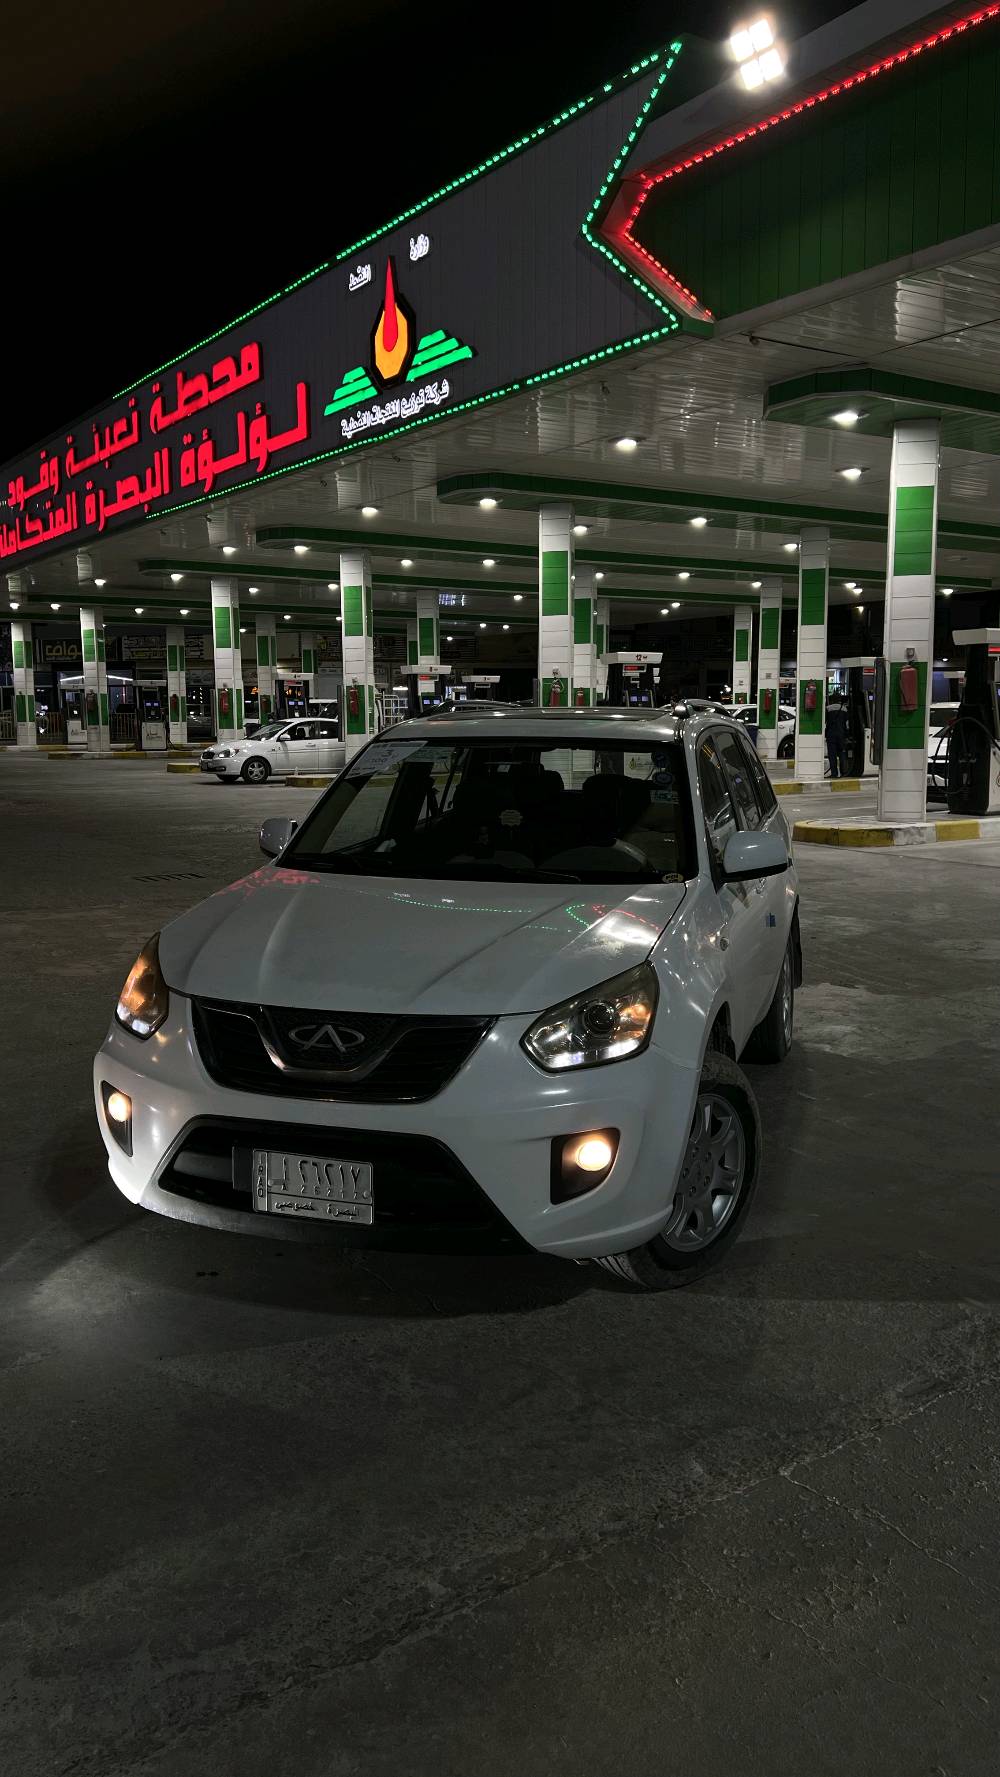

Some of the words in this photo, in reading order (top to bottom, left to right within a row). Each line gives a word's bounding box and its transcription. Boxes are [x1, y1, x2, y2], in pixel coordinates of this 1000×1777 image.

[349, 264, 372, 291] النفط
[150, 341, 261, 434] محطة
[425, 379, 450, 405] شركة
[371, 398, 401, 425] المنتجات
[401, 388, 425, 418] توزيع
[66, 397, 139, 478] تعبئة
[180, 381, 308, 493] لؤلؤة
[340, 411, 372, 439] النفطية
[7, 450, 60, 511] وقود
[84, 447, 170, 532] البصرة
[0, 490, 78, 560] المتكامل
[274, 1201, 316, 1213] خصوصي
[326, 1203, 361, 1220] البصرة
